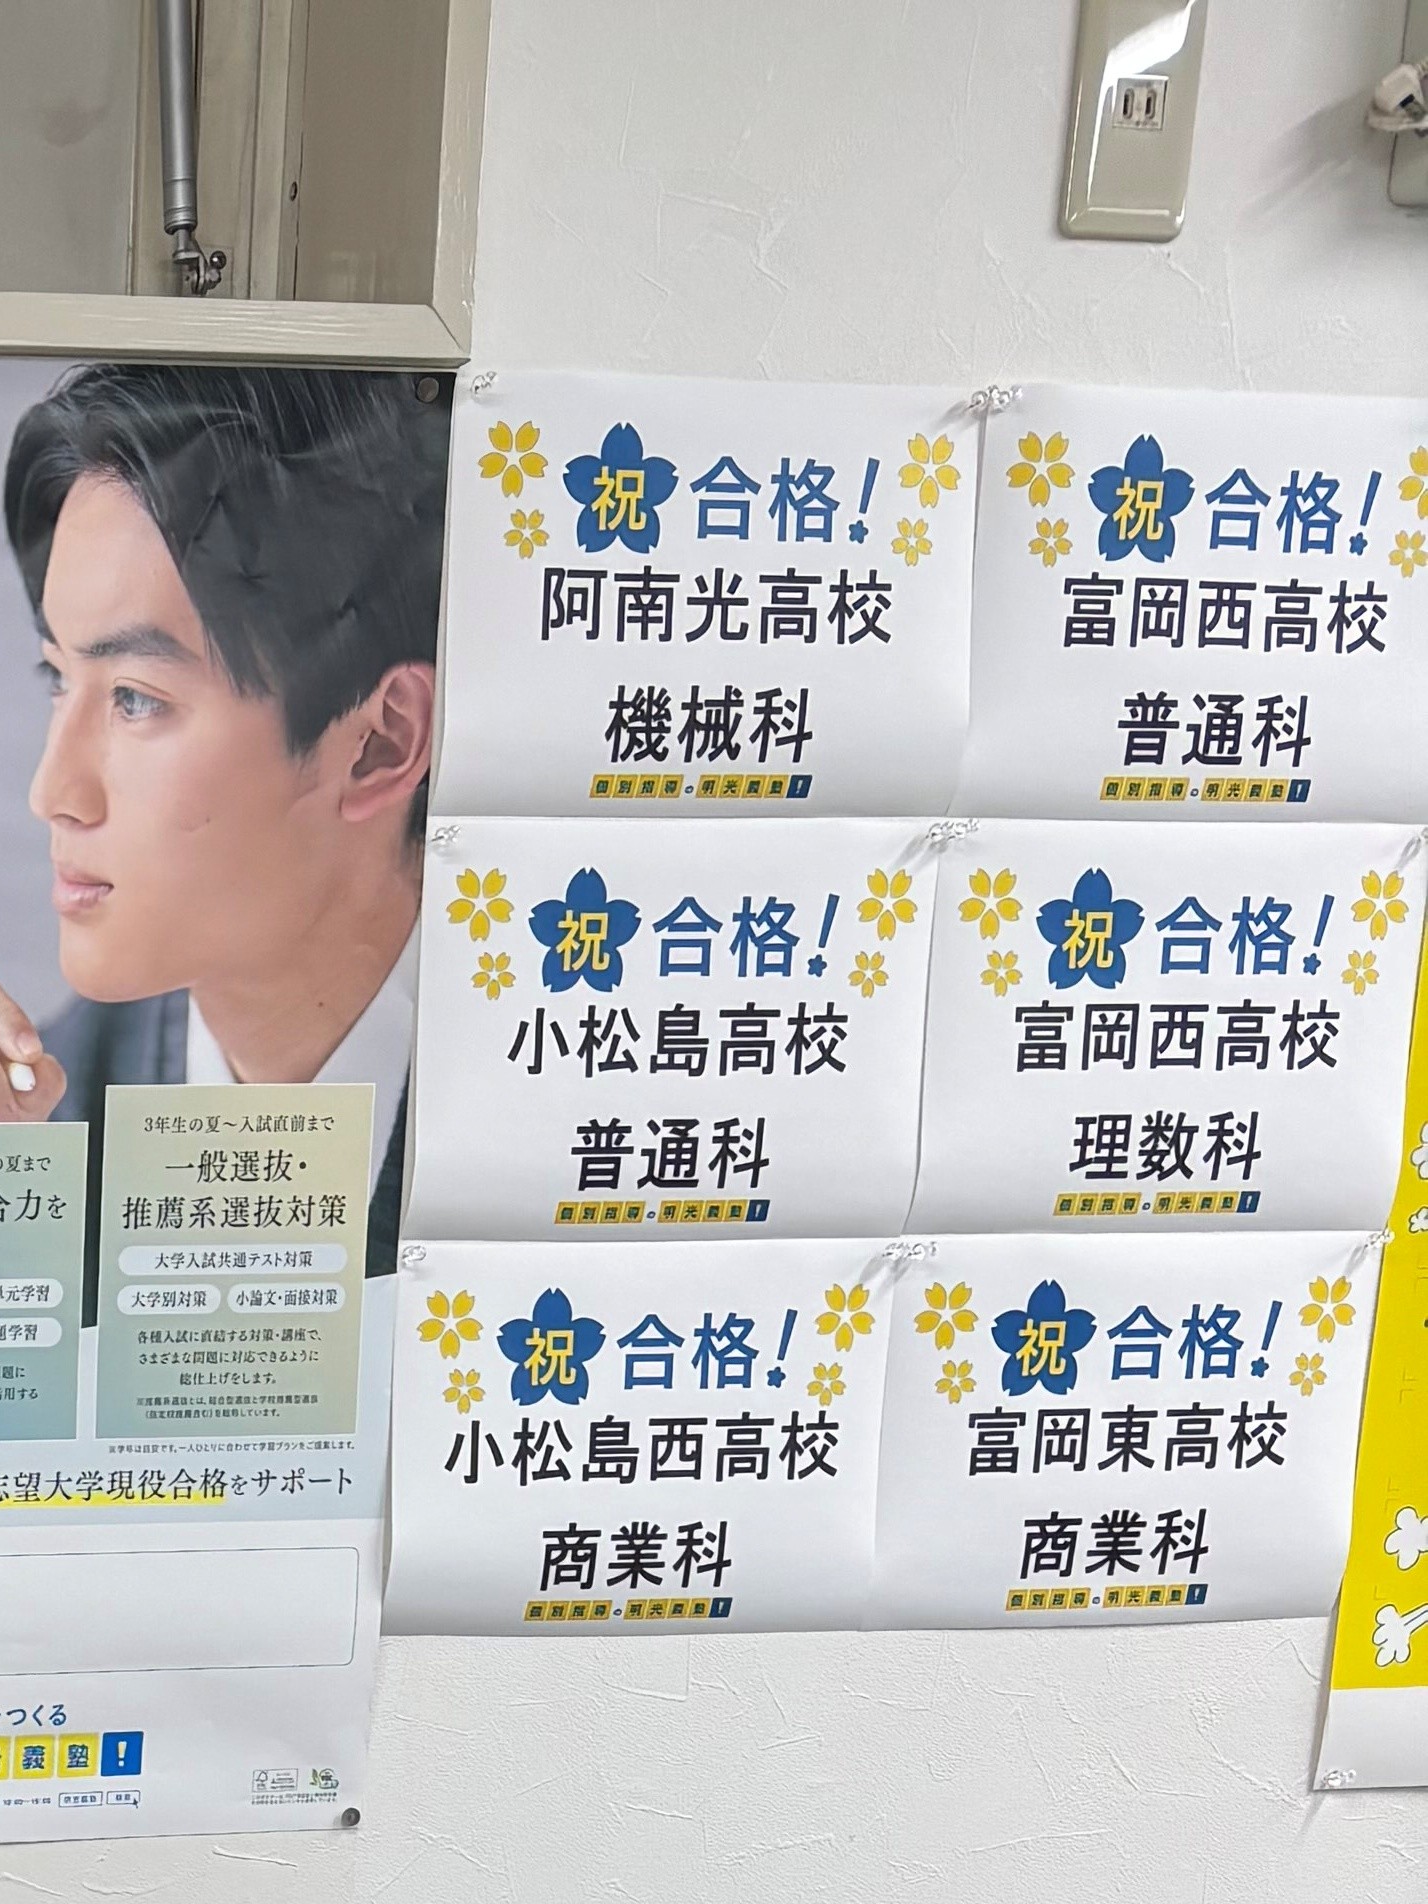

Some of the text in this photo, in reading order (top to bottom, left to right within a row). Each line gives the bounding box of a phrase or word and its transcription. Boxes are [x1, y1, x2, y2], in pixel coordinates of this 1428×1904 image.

[593, 468, 647, 532] 祝
[1113, 478, 1165, 543] 祝
[541, 567, 893, 645] 阿南光高校
[1061, 573, 1388, 654] 富岡西高校
[605, 686, 813, 765] 機械科
[1116, 694, 1312, 768] 普通科
[556, 909, 610, 972] 祝
[1062, 909, 1115, 972] 祝
[507, 1003, 850, 1078] 小松島高校
[1014, 999, 1341, 1073] 富岡西高校
[165, 1149, 307, 1183] 一般選抜・
[571, 1117, 772, 1191] 普通科
[1069, 1111, 1263, 1180] 理数科
[122, 1195, 347, 1230] 推薦系選抜対策
[154, 1251, 313, 1270] 大学入試共通テスト対策
[132, 1290, 207, 1308] 大学別対策
[235, 1289, 338, 1307] 小論文・面接対策
[138, 1328, 322, 1345] 各種入試に直結する対策・講座で、
[138, 1349, 319, 1365] さまざまな問題に対応できるように
[523, 1326, 577, 1387] 祝
[1017, 1317, 1068, 1377] 祝
[179, 1371, 277, 1386] 総仕上げをします。
[443, 1414, 841, 1486] 小松島西高校
[966, 1402, 1289, 1478] 富岡東高校
[540, 1520, 733, 1591] 商業科
[1020, 1509, 1210, 1580] 商業科
